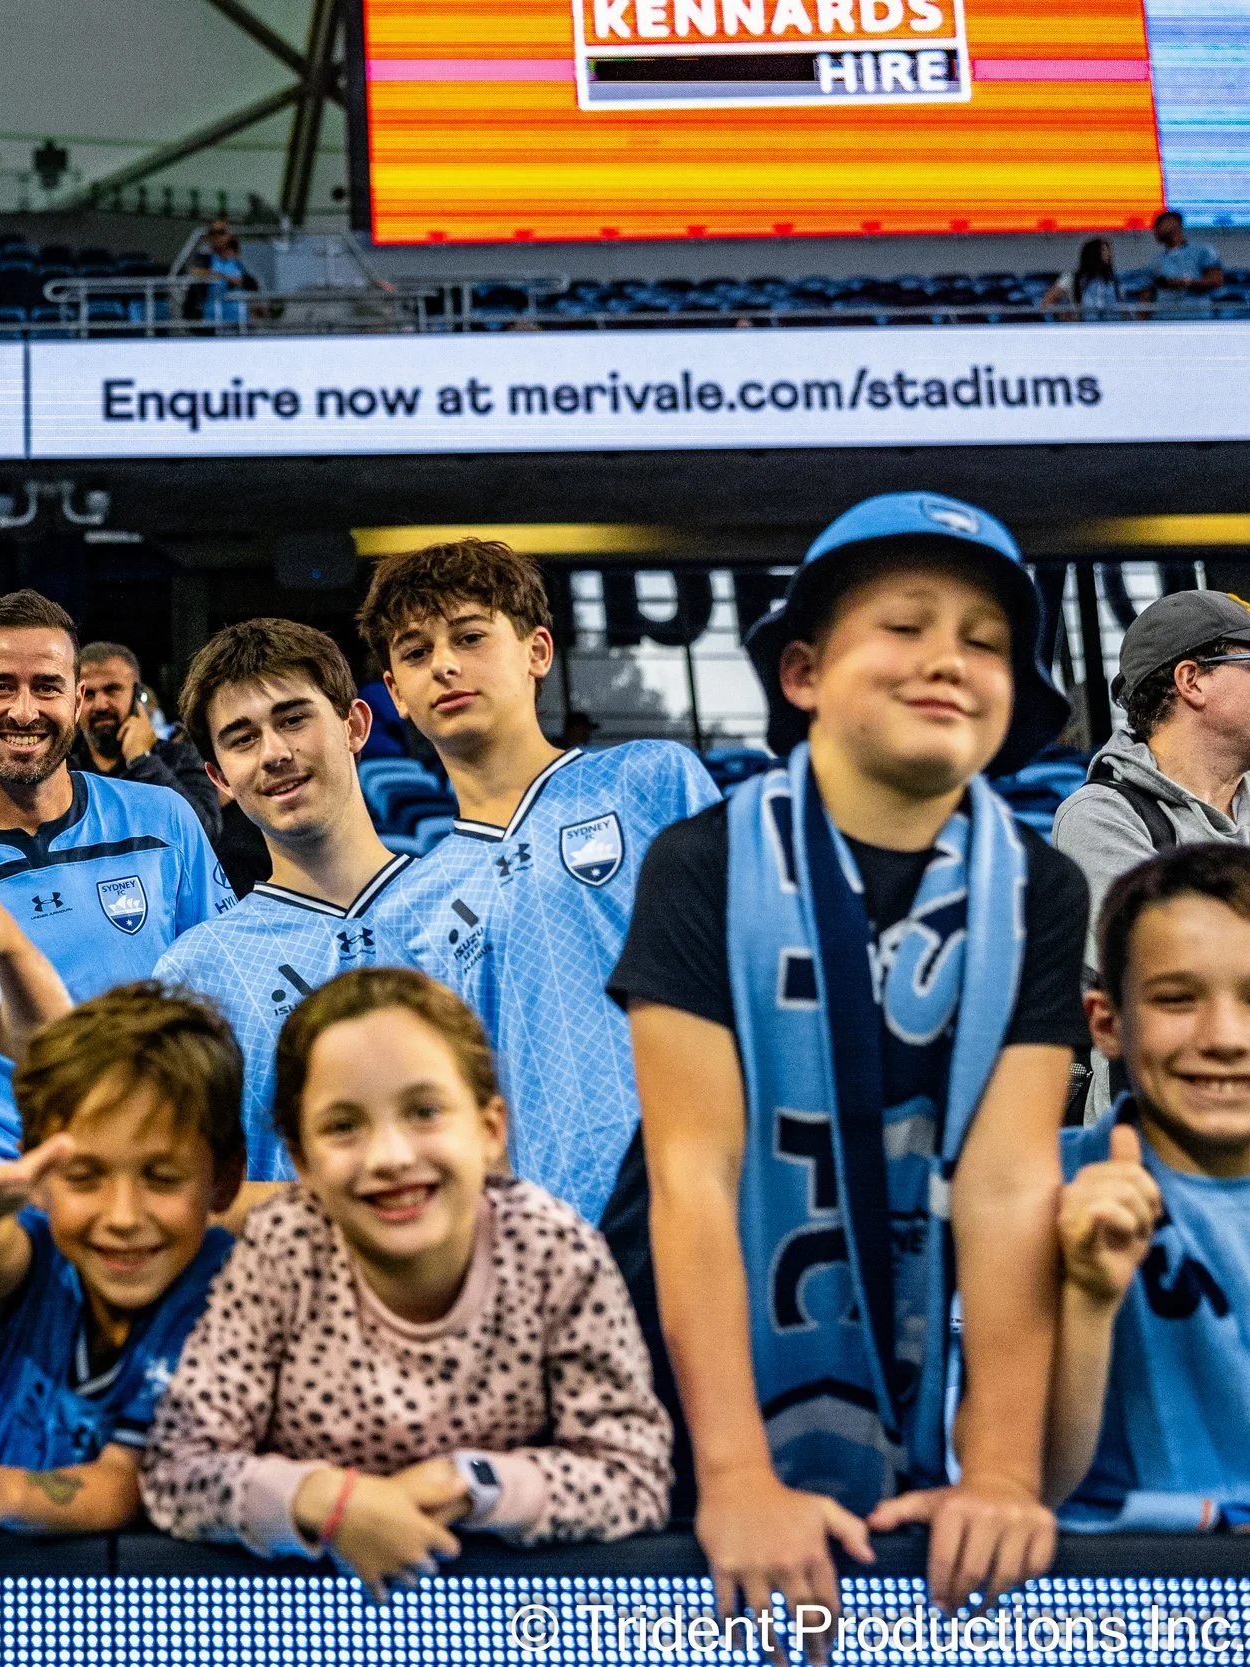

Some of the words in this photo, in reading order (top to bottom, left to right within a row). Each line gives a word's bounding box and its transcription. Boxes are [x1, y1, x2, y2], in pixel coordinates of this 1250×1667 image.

[593, 0, 944, 38] KENNARDS
[816, 50, 949, 94] HIRE
[102, 378, 300, 432] Enquire
[316, 386, 421, 418] now
[437, 377, 493, 416] at
[507, 366, 1102, 415] merivale.com/stadiums
[566, 820, 610, 840] SYDNEY
[101, 880, 136, 893] SYDNEY
